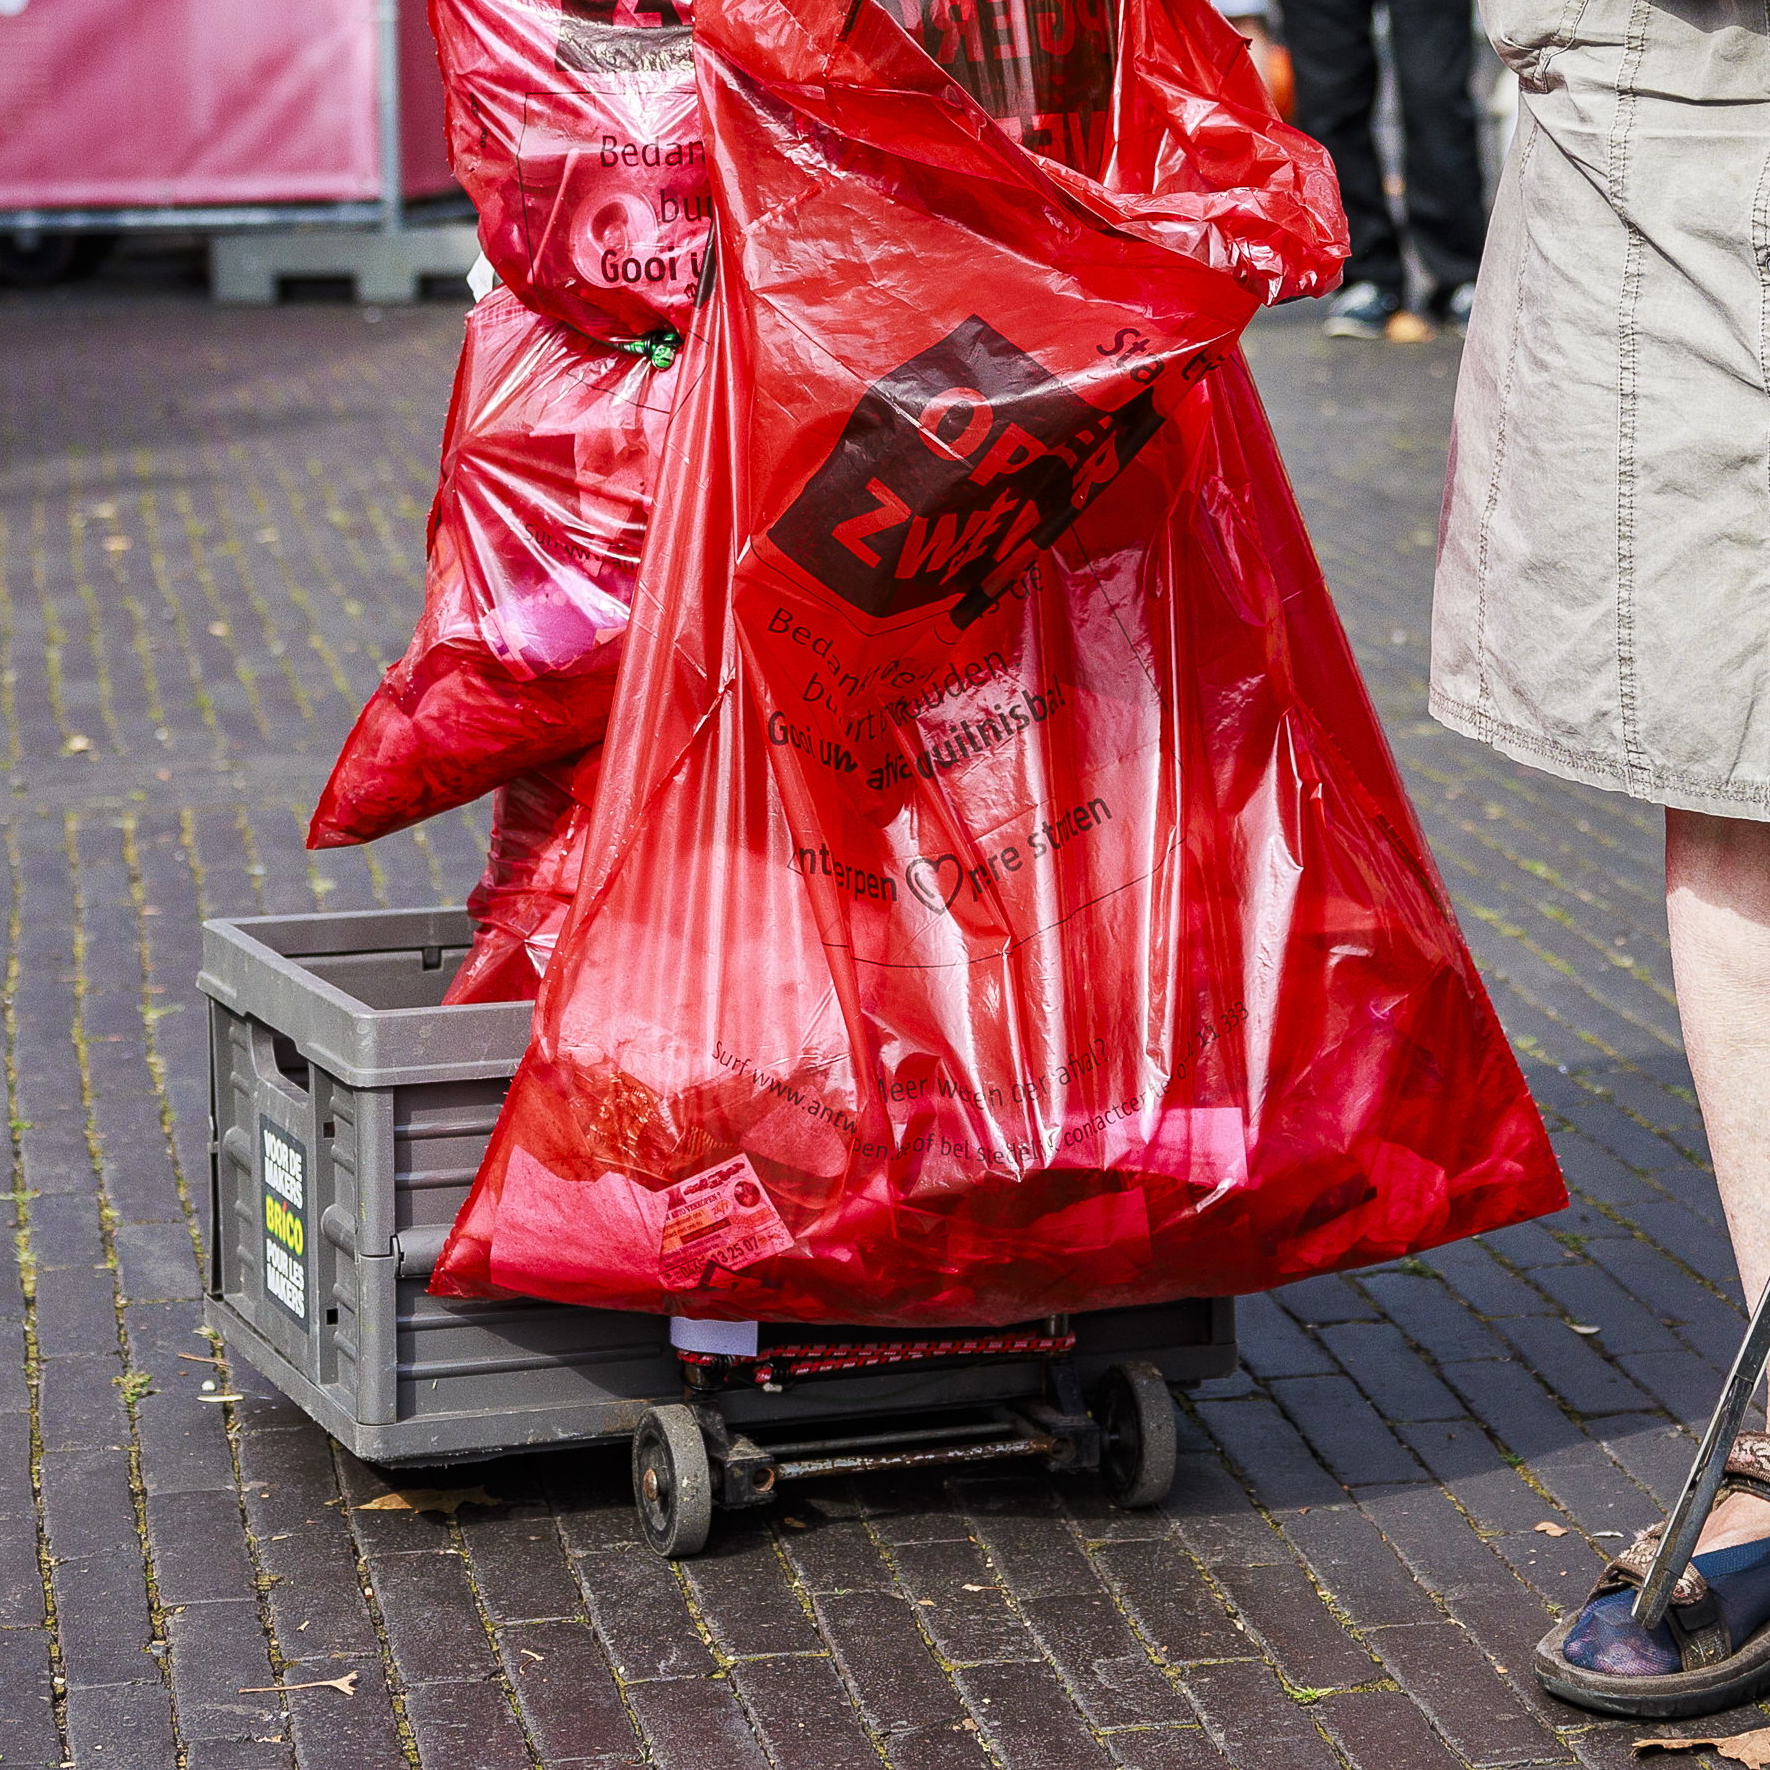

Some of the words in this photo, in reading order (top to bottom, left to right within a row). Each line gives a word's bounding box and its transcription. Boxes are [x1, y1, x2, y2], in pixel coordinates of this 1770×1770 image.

[601, 246, 677, 283] Gooi
[711, 1040, 752, 1078] Surf
[912, 1132, 935, 1154] of
[941, 1138, 969, 1163] bel
[1219, 1001, 1249, 1034] 333
[1055, 1038, 1109, 1086] afval?
[264, 1129, 289, 1167] VOOR
[288, 1147, 303, 1182] DE
[265, 1156, 303, 1209] MAKERS
[266, 1237, 290, 1275] POUR
[288, 1256, 305, 1291] LES
[727, 1243, 745, 1261] 25
[742, 1235, 760, 1254] 07
[266, 1262, 306, 1319] MAKERS
